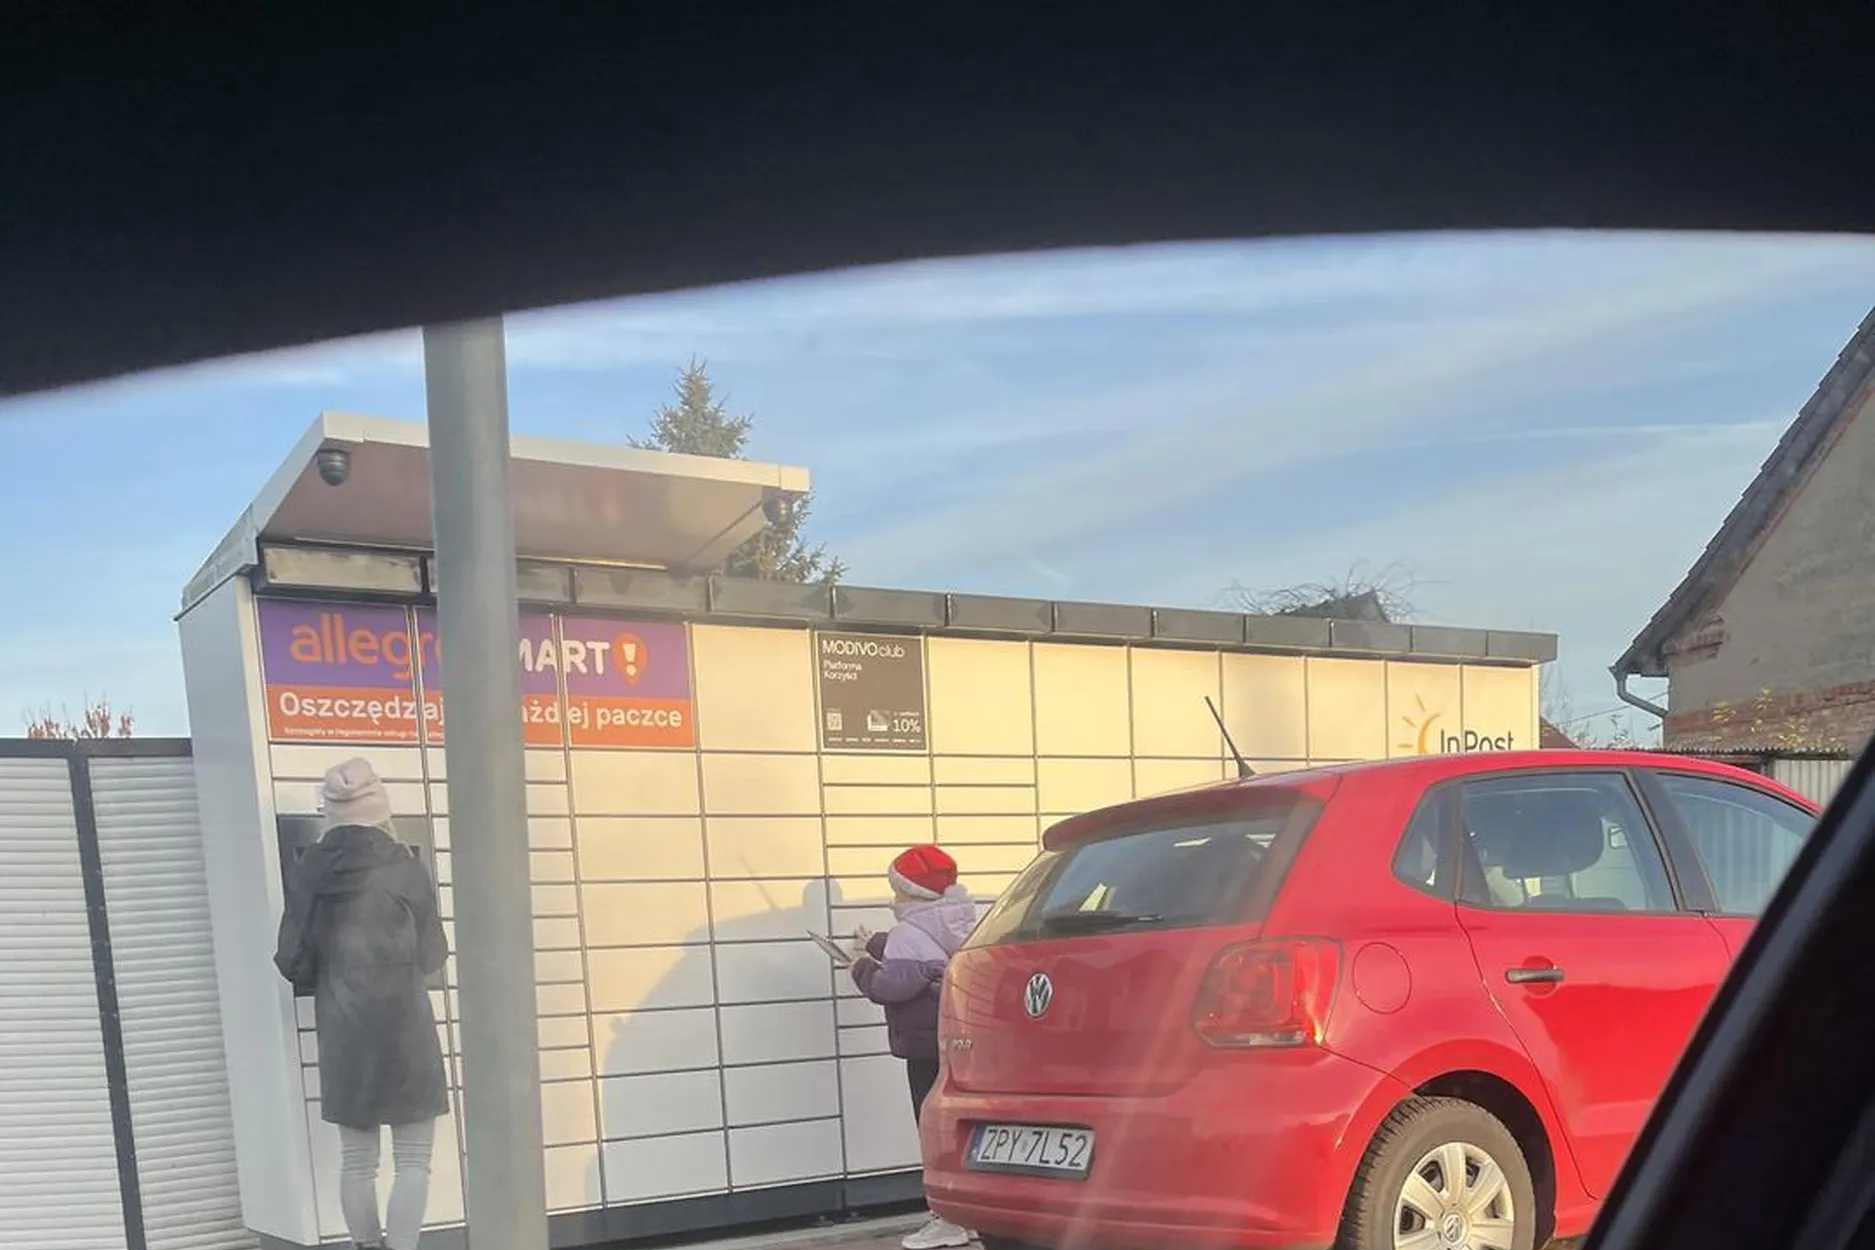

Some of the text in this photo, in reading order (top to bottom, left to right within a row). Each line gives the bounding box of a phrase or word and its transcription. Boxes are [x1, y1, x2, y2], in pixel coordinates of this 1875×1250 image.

[290, 612, 441, 680] allegr
[279, 691, 683, 730] Oszczędzaj żdej paczce
[892, 718, 921, 733] 10%
[1440, 728, 1515, 753] InPost
[980, 1129, 1088, 1168] ZPY 7L52
